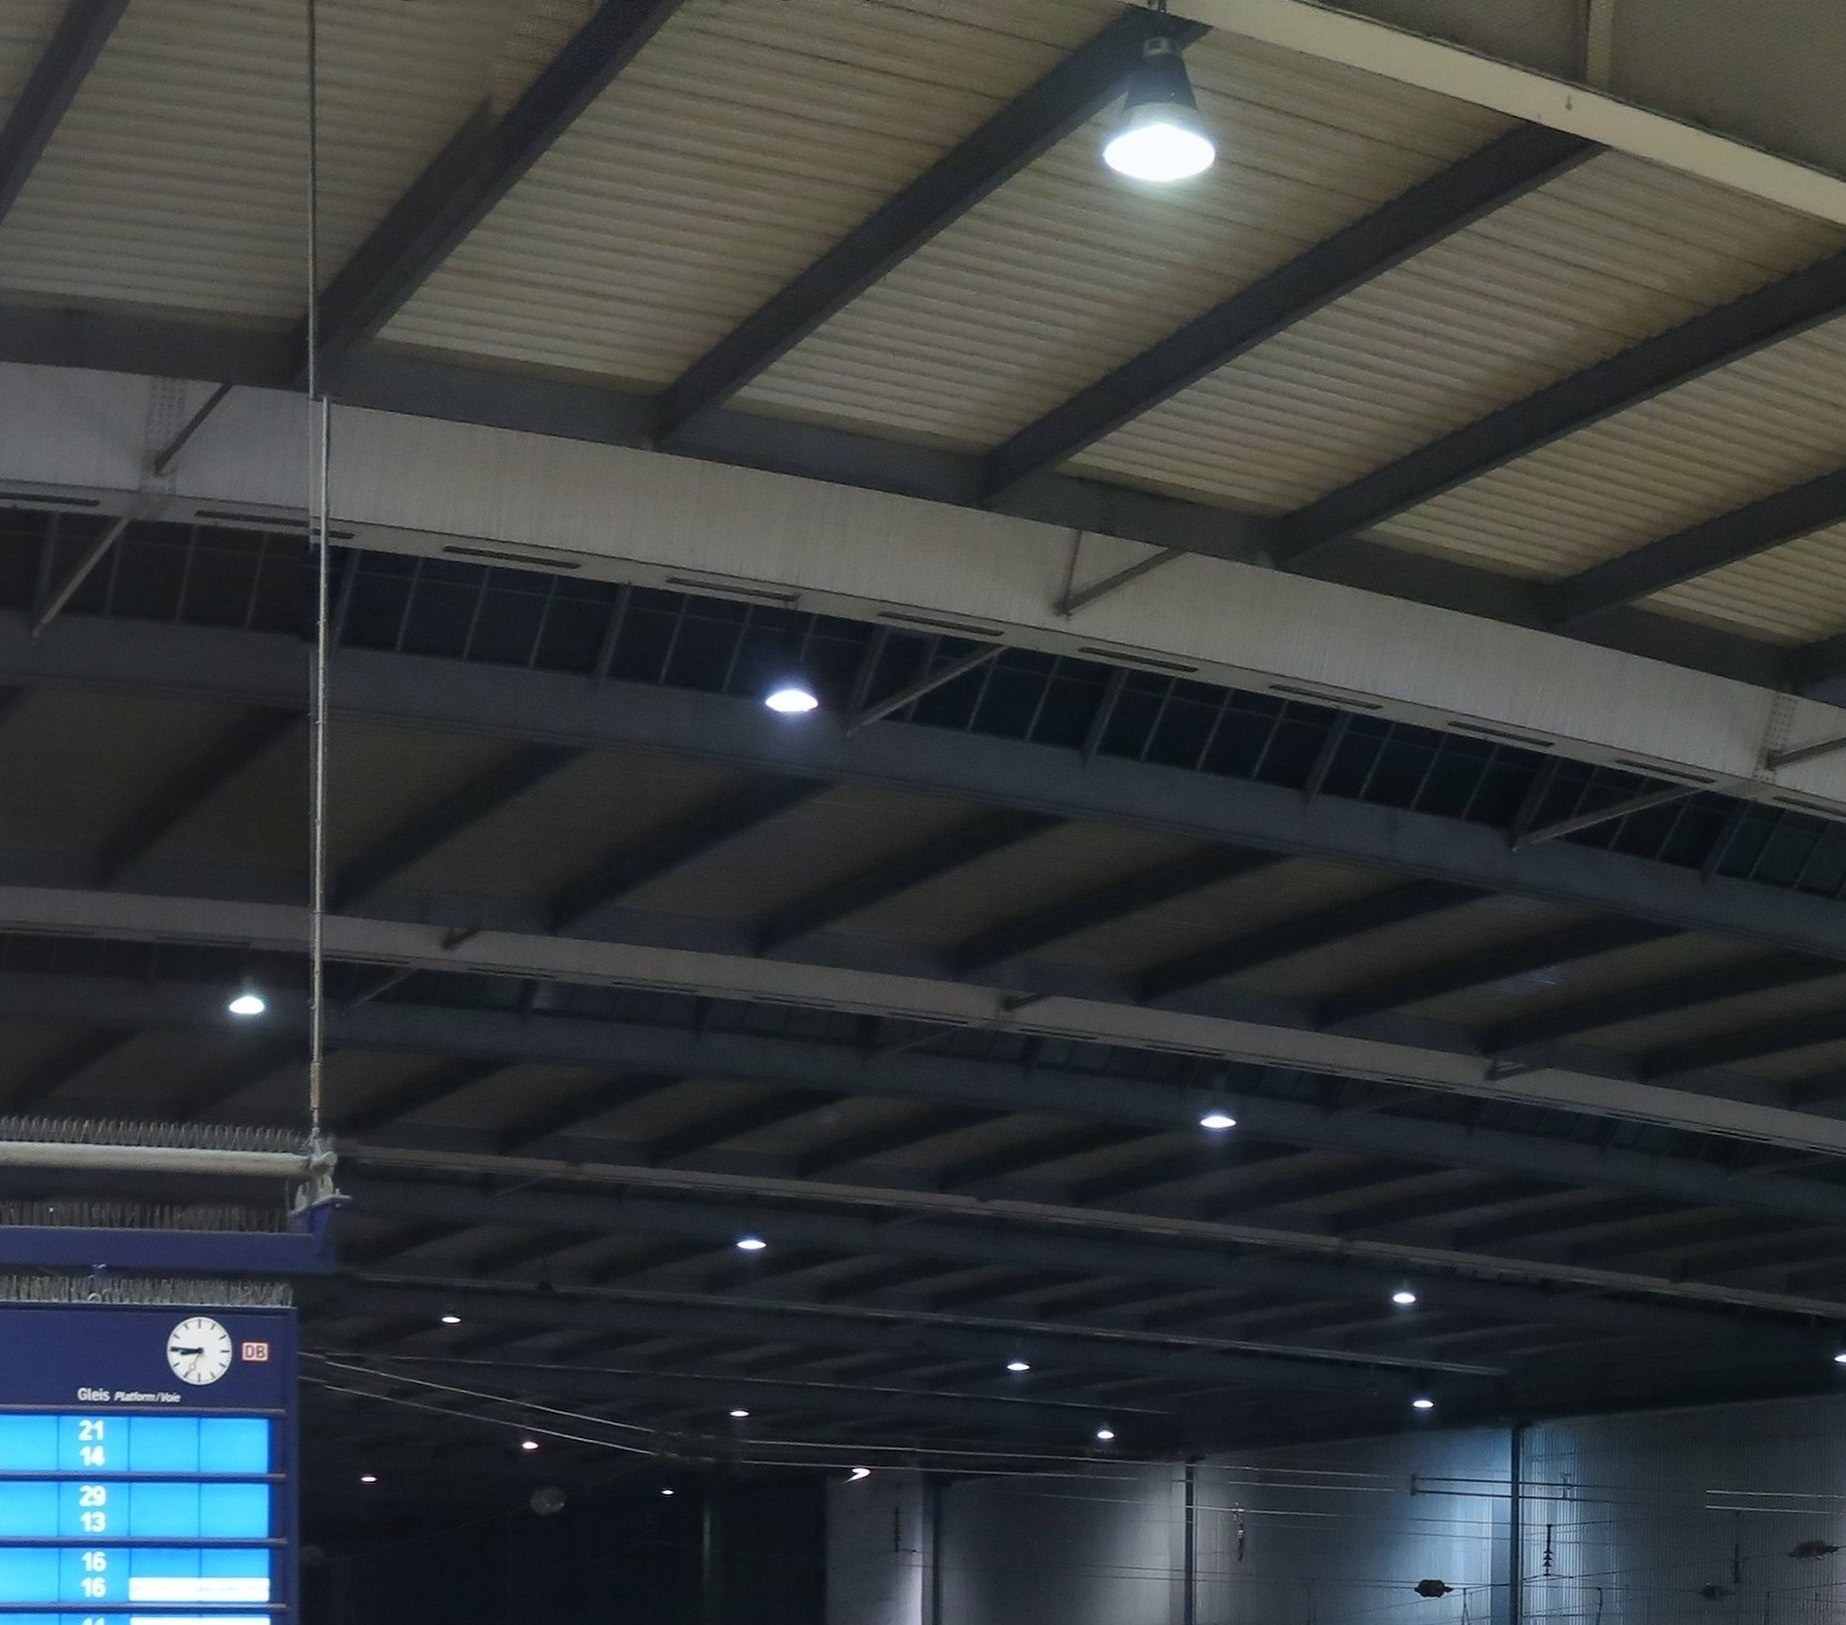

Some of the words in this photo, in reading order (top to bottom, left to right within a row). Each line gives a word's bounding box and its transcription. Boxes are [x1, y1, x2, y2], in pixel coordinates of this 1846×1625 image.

[243, 1343, 268, 1361] DB
[78, 1387, 110, 1402] Gleis
[114, 1390, 181, 1404] Platform/Voie
[78, 1420, 105, 1441] 21
[80, 1447, 105, 1467] 14
[79, 1486, 106, 1507] 29
[80, 1511, 106, 1532] 13
[81, 1552, 106, 1572] 16
[81, 1578, 106, 1598] 16
